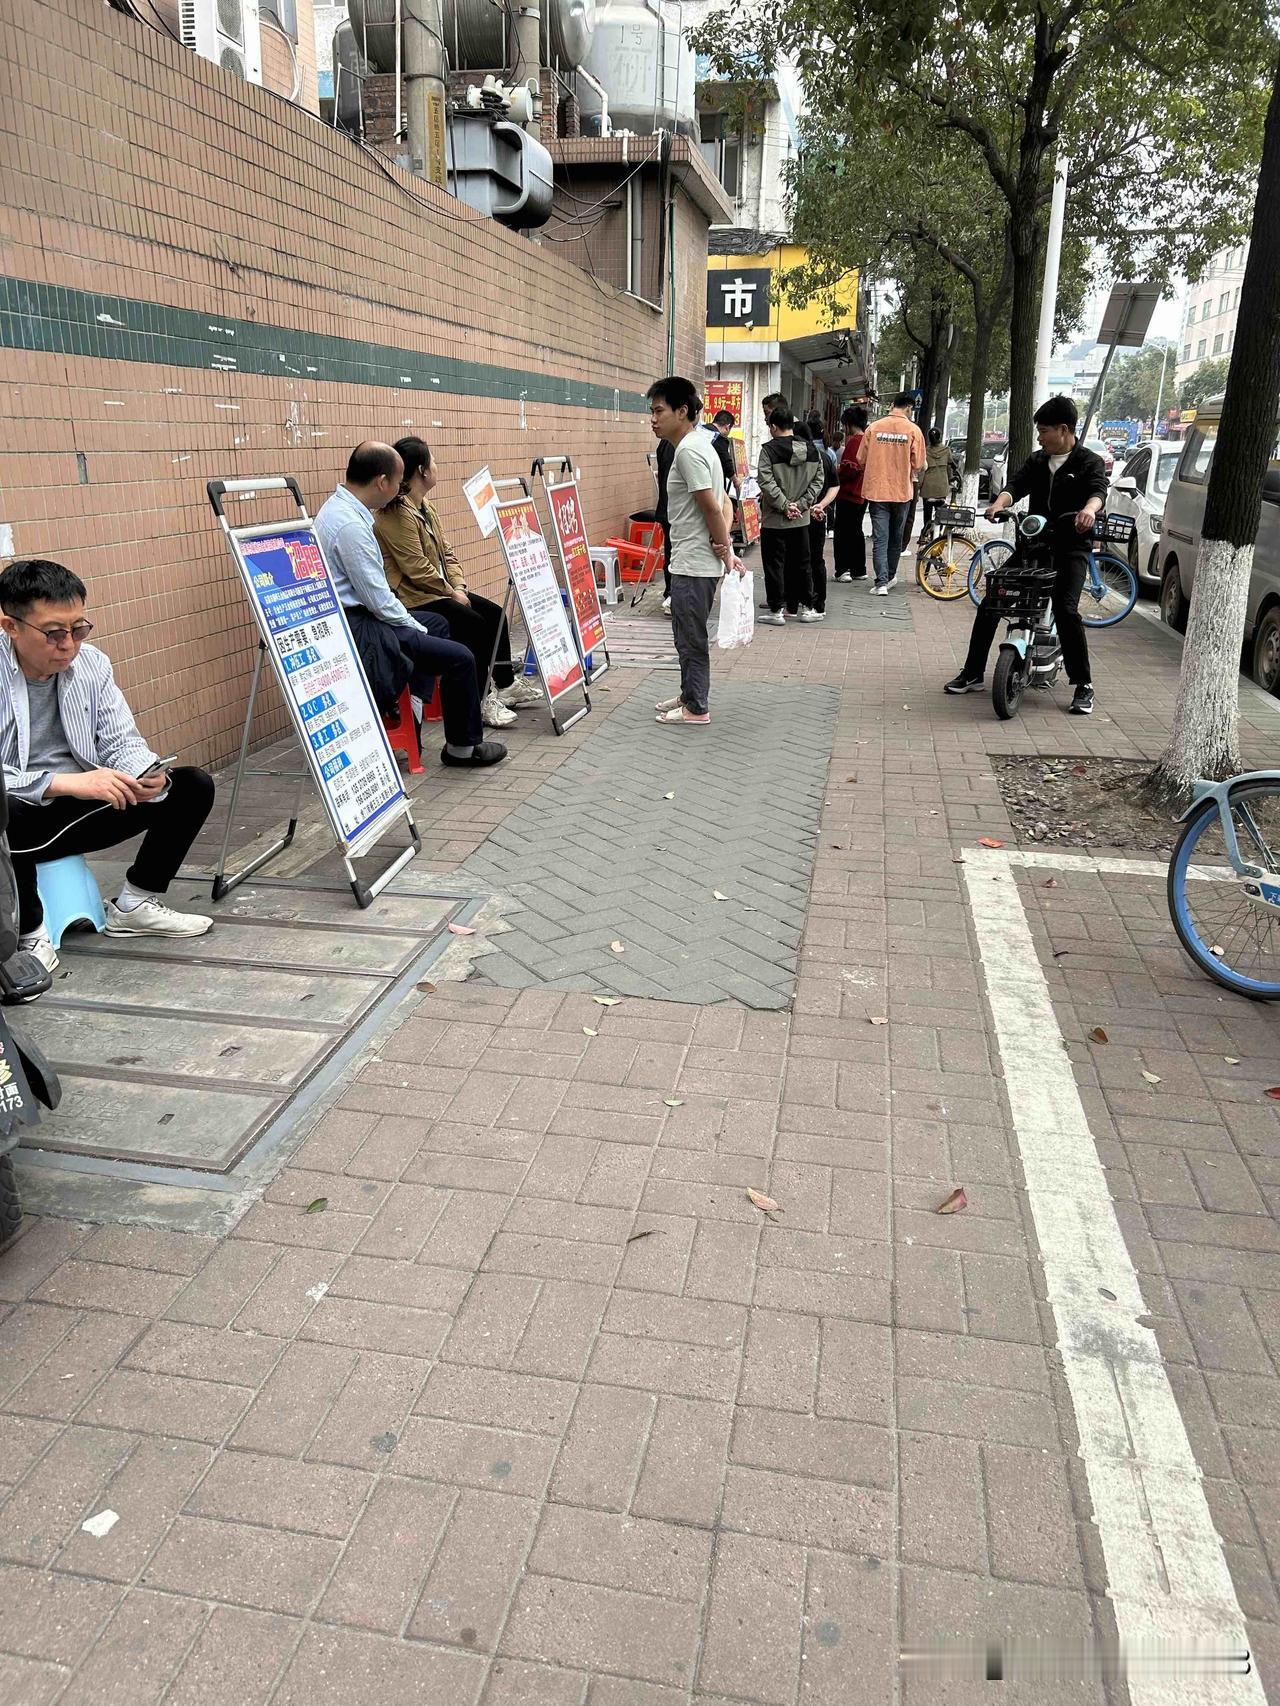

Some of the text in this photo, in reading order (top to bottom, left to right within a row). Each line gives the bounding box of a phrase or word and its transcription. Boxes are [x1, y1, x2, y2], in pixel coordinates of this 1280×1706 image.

[720, 277, 757, 319] 市
[556, 496, 579, 537] 招聘
[284, 540, 327, 581] 招聘
